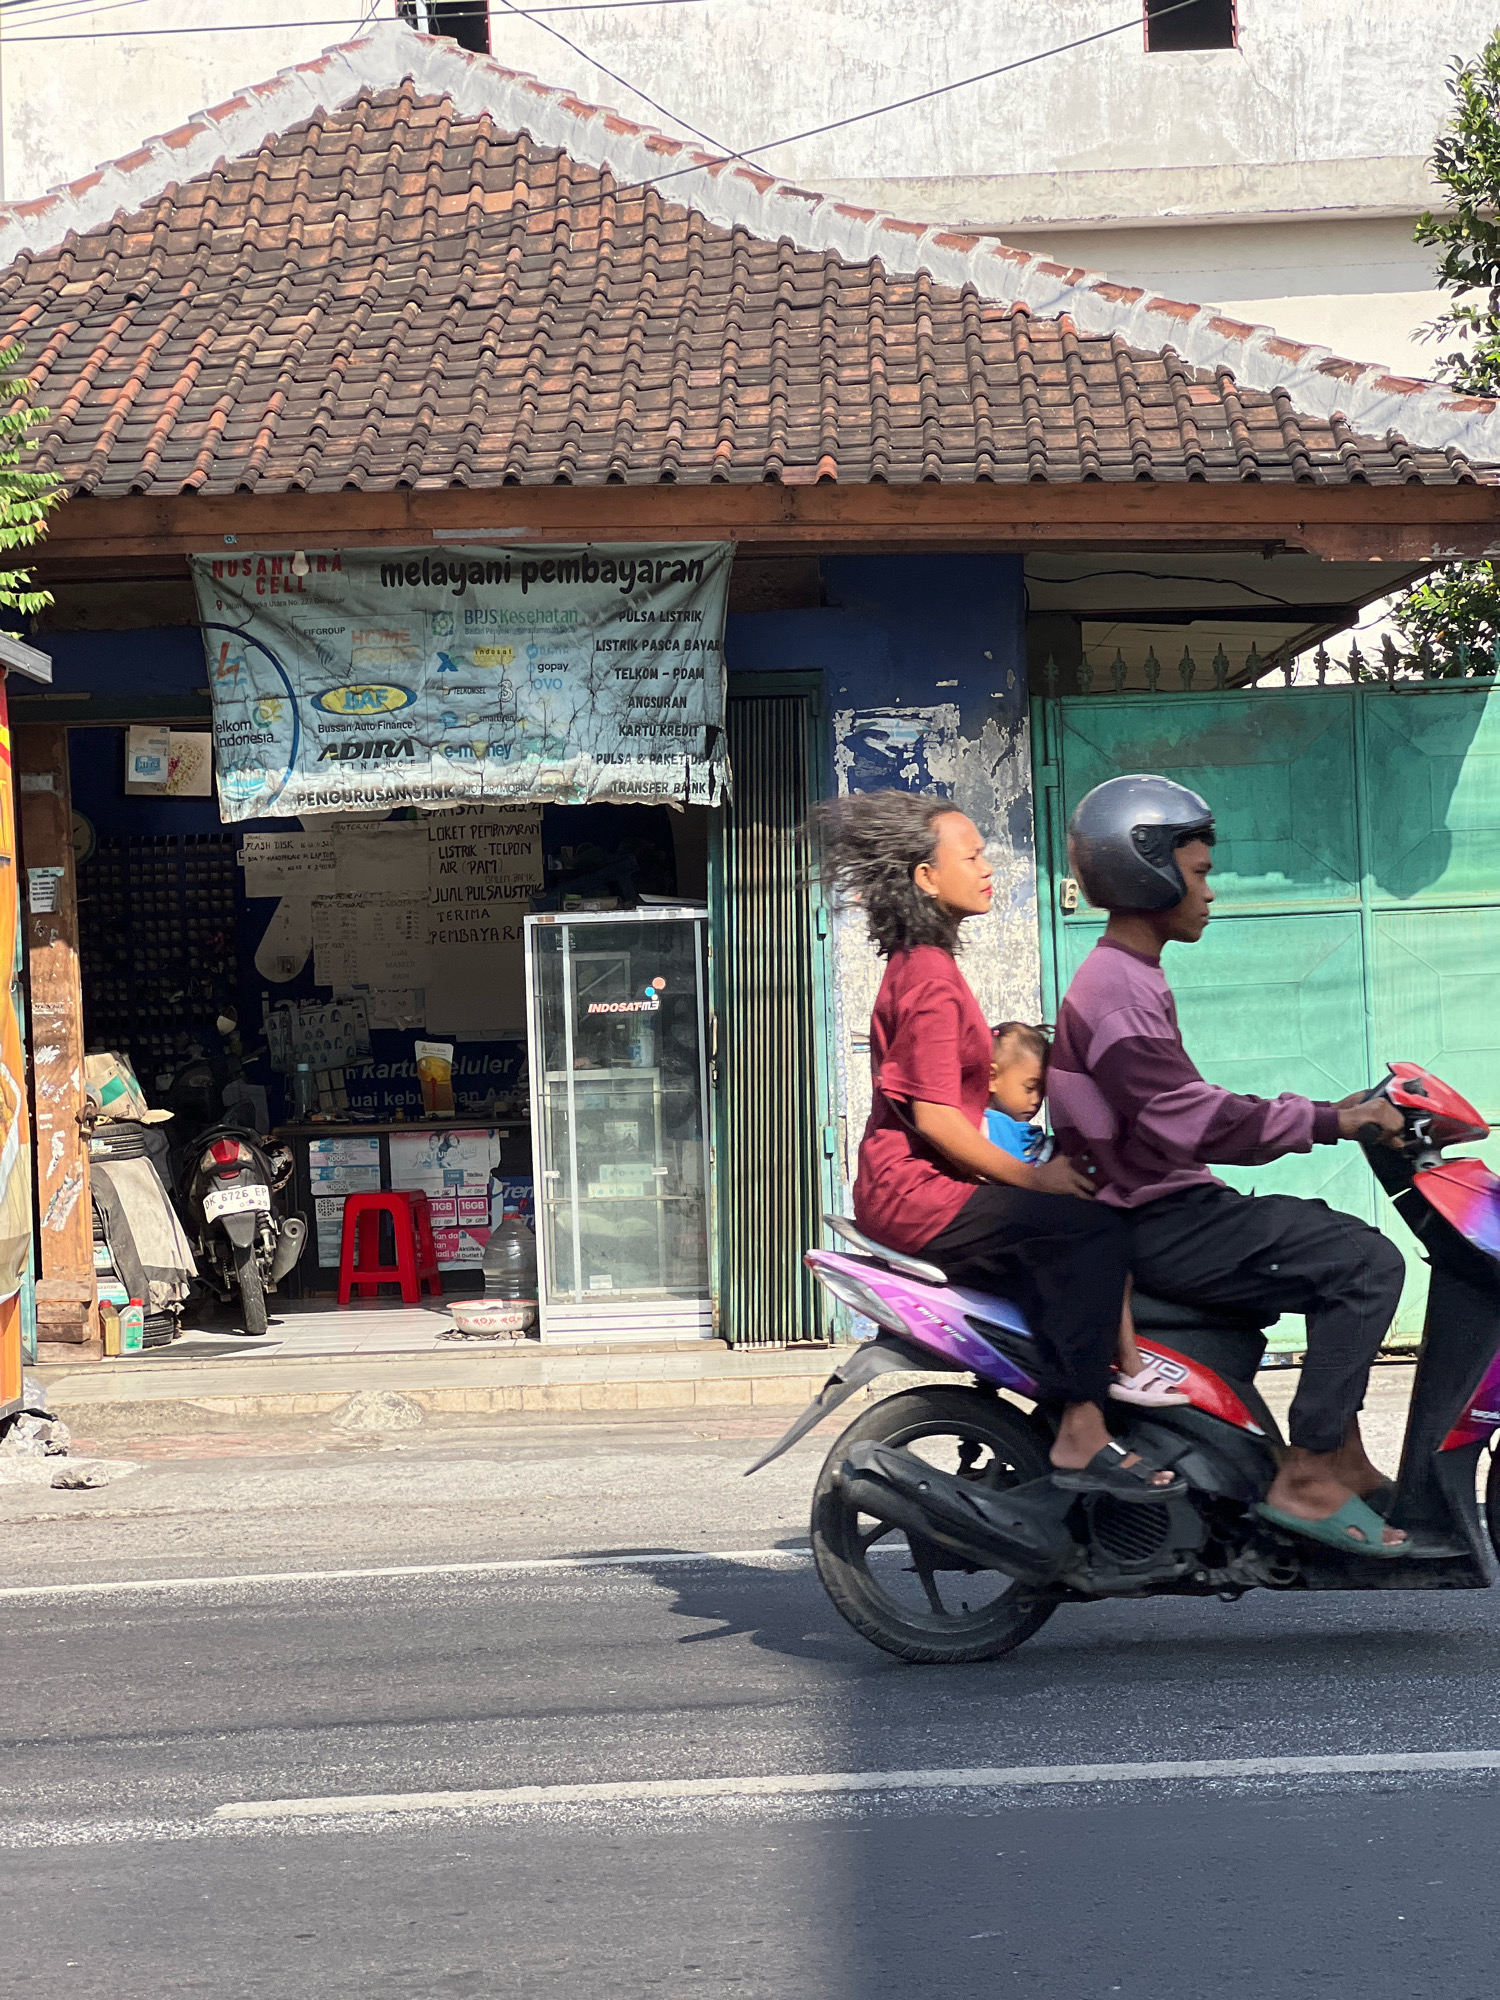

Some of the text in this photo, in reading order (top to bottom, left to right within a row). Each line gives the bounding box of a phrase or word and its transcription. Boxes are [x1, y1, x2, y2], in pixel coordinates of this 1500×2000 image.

[380, 552, 704, 597] melayani pembayaran
[256, 576, 307, 595] CELL
[268, 600, 287, 608] Utara
[464, 608, 578, 625] BPJS Kesehatan
[619, 611, 702, 622] PULSA LISTRIK
[303, 626, 346, 637] FIFGROUP
[351, 628, 411, 645] HOME
[475, 647, 513, 655] indosat
[596, 640, 638, 651] LISTRIK
[641, 639, 680, 651] PASCA
[537, 663, 569, 673] gopay
[614, 668, 658, 680] TELKOM
[673, 668, 704, 680] PDAM
[533, 678, 564, 690] OVO
[453, 687, 487, 695] TELKOMSEL
[342, 688, 389, 710] BAF
[628, 696, 687, 708] ANGSURAN
[215, 719, 252, 733] elkom
[318, 720, 413, 734] Bussan Auto Finance
[619, 724, 699, 737] KARTU KREDIT
[216, 732, 274, 748] Indonesia
[317, 738, 415, 761] ADIRA
[340, 759, 416, 770] FINANCE
[596, 753, 632, 765] PULSA
[649, 753, 686, 766] PAKET
[611, 781, 706, 794] TRANSFER BANK
[297, 785, 411, 806] PENGURUSAN
[412, 784, 455, 800] STNK
[428, 823, 540, 842] LOKET PEMBAYARAN
[274, 840, 294, 849] DISK
[438, 844, 477, 859] LISTRIK
[439, 861, 458, 874] AIR
[432, 882, 542, 904] JUAL PULSA LISTRIK
[436, 908, 491, 922] TERIMA
[362, 1061, 419, 1079] Kartu
[450, 1054, 514, 1076] eluler
[205, 1187, 267, 1210] DK 6726 EP
